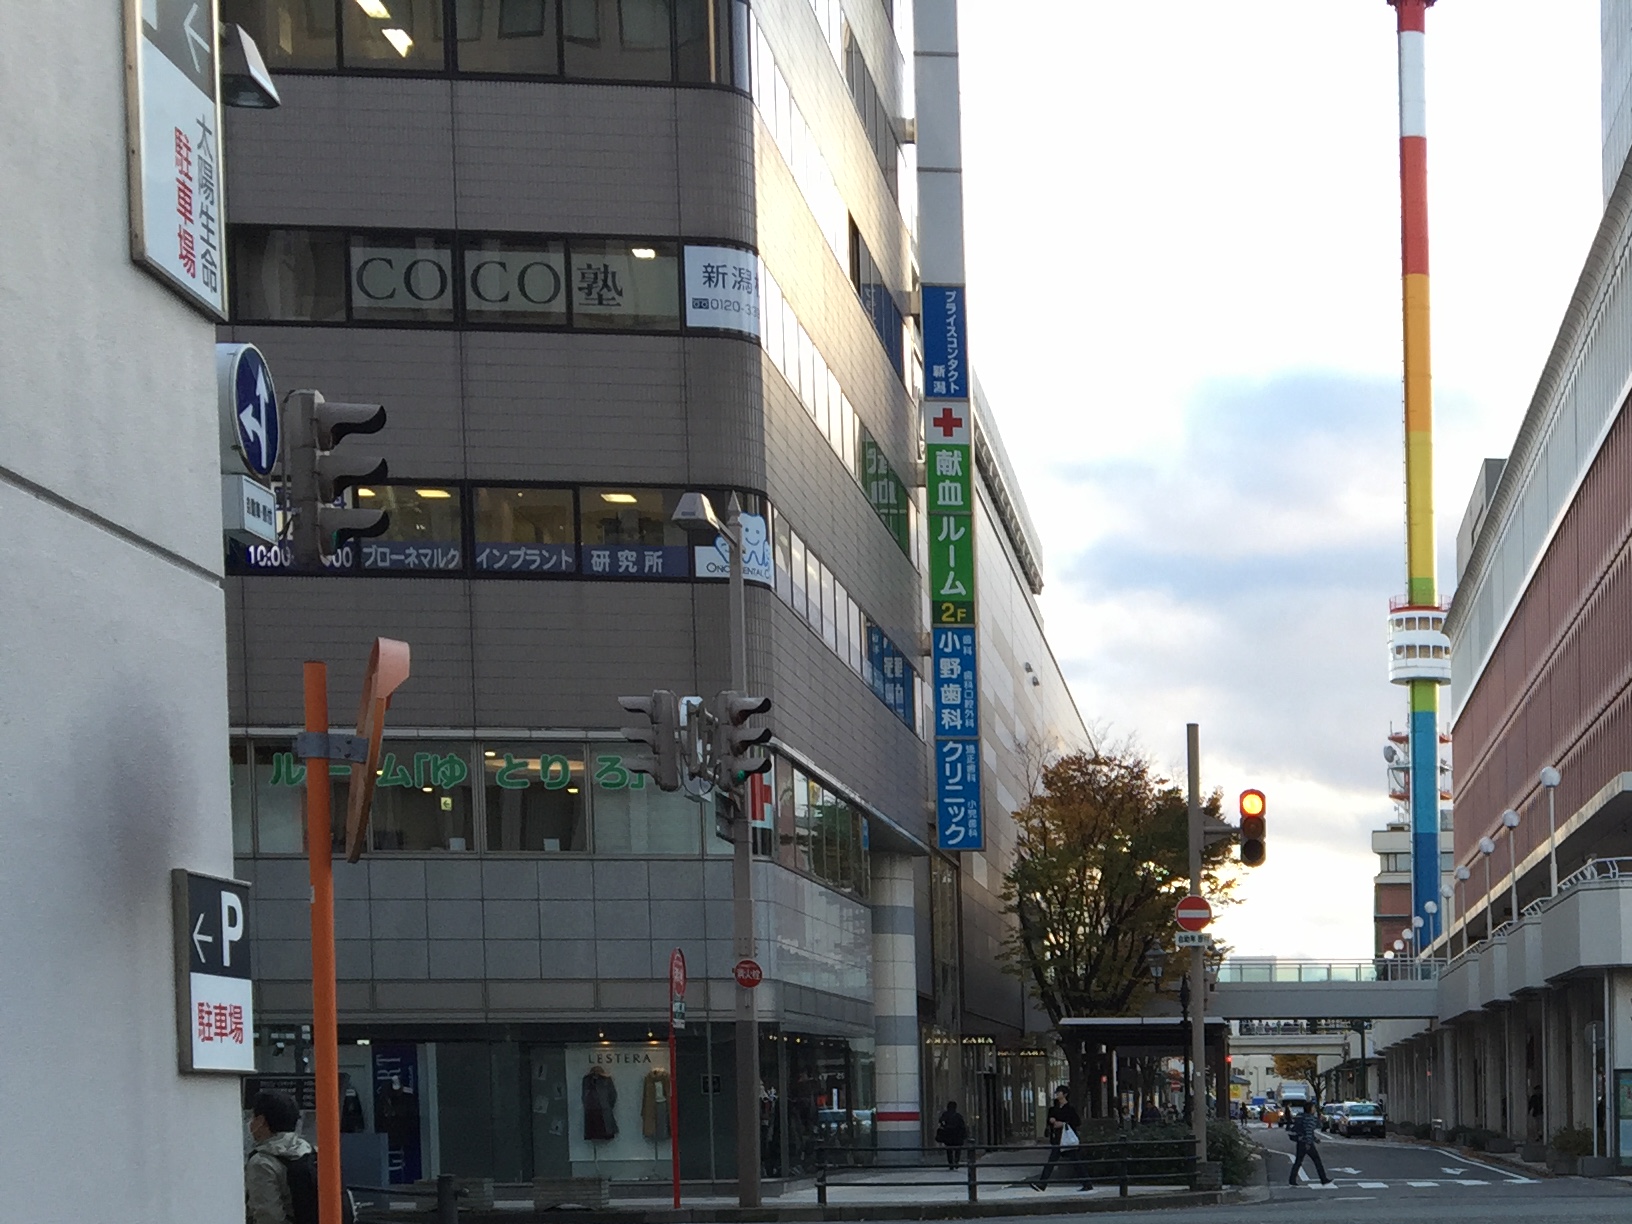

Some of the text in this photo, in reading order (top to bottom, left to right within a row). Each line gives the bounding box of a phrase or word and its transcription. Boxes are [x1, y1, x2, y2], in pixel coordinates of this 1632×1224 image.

[175, 126, 196, 279] 駐車場
[196, 114, 217, 293] 太陽生命
[702, 263, 759, 296] 新潟
[932, 364, 947, 395] 新潟
[475, 545, 573, 571] インプラント
[591, 549, 664, 574] 研究所
[743, 566, 764, 578] ENTAL
[941, 601, 967, 622] 2F
[221, 890, 244, 967] P
[197, 1001, 244, 1045] 駐車場
[588, 1053, 652, 1064] LESTERA
